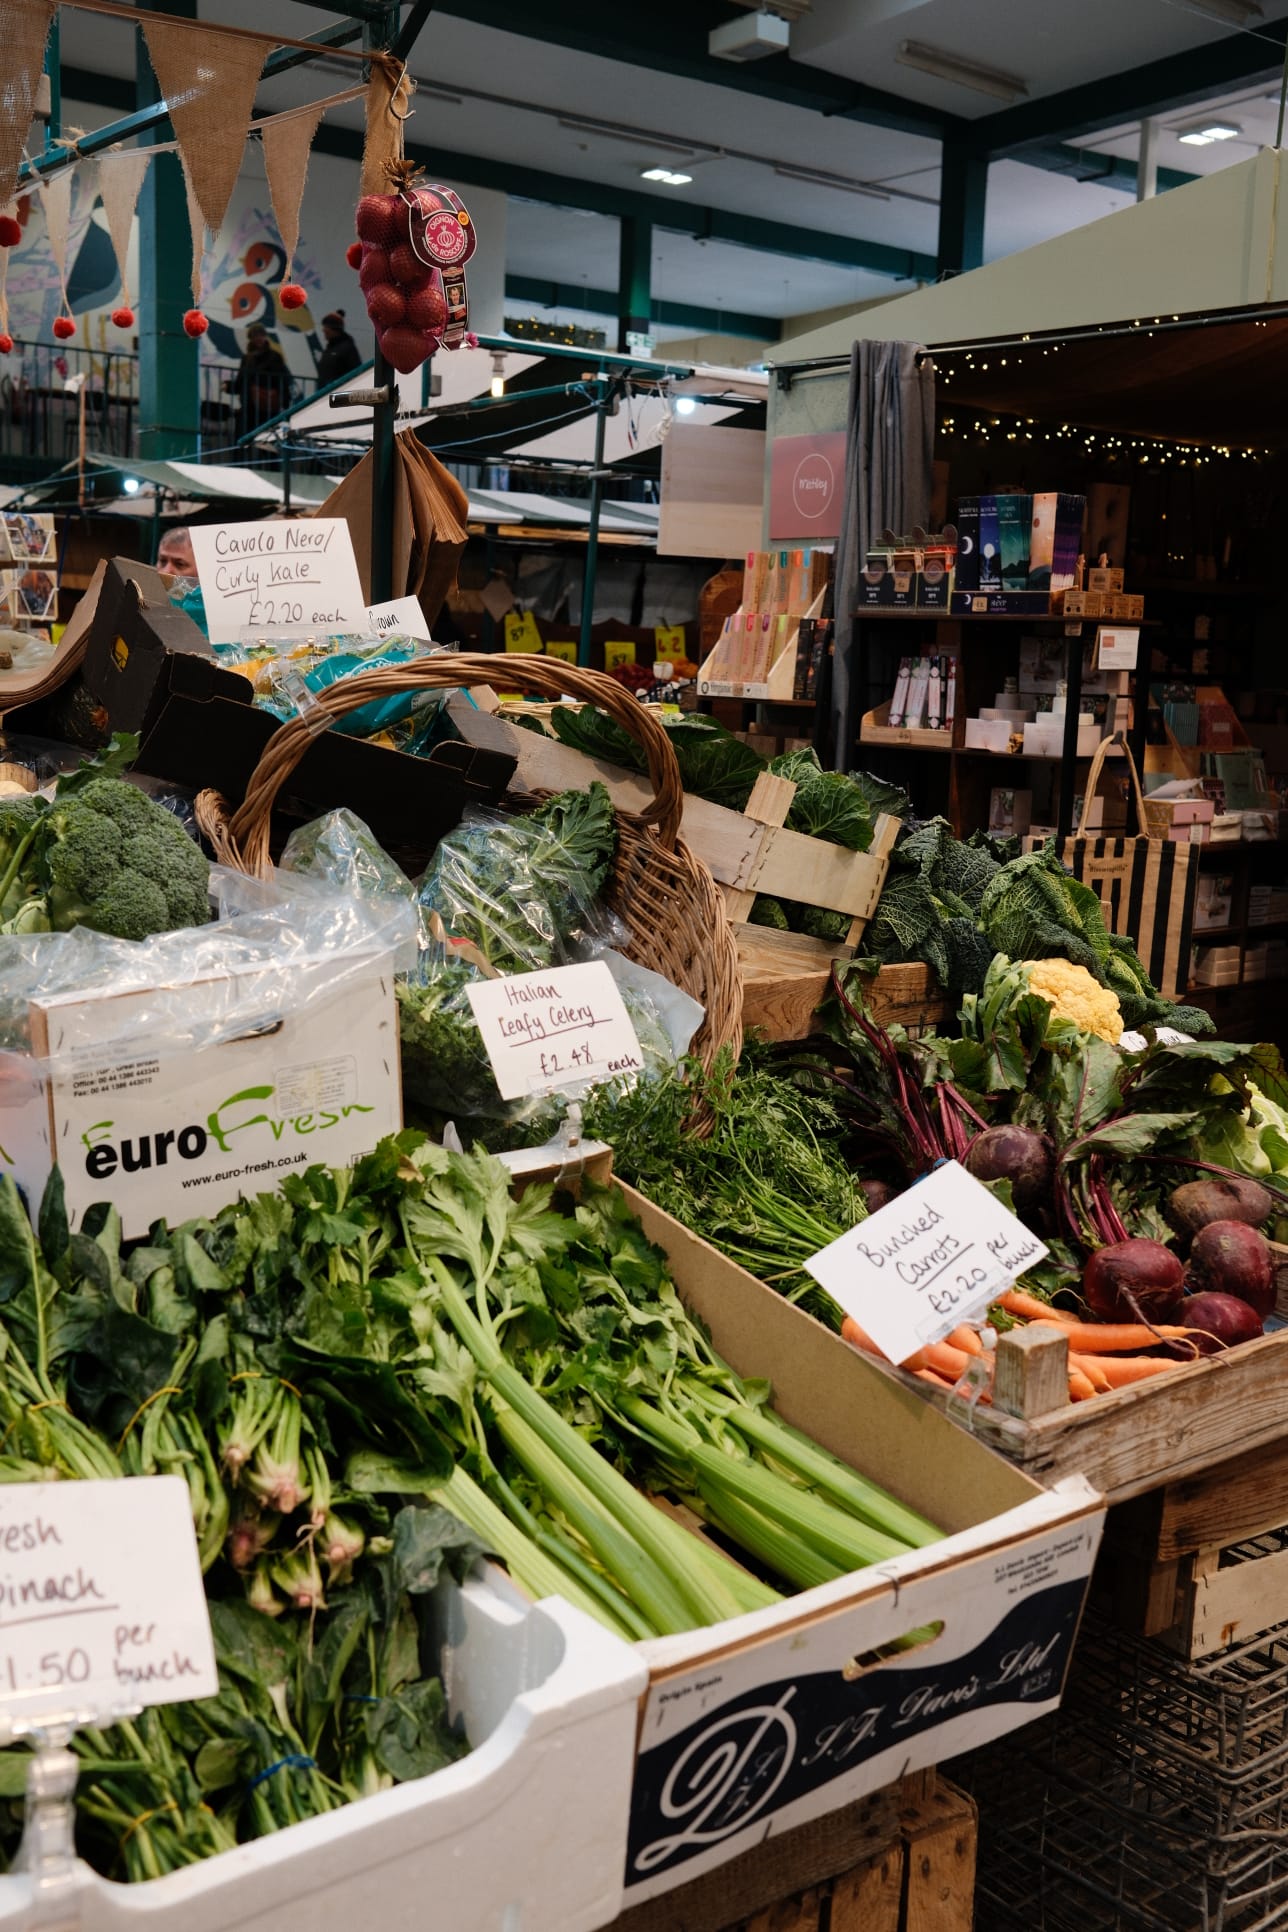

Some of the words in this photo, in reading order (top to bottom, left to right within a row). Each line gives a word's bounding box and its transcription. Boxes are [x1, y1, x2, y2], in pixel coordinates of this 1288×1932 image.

[430, 215, 455, 230] OIGNON
[215, 530, 274, 555] Cavolo
[286, 526, 335, 553] Nero/
[215, 565, 260, 603] Curly
[249, 601, 303, 626] £2.20
[312, 608, 347, 624] each
[504, 983, 562, 1006] Italian
[498, 1012, 547, 1040] Leafy
[550, 1004, 596, 1028] Celery
[540, 1041, 594, 1077] £2.48
[607, 1053, 640, 1072] each
[182, 1152, 308, 1189] www.euro-fresh.co.uk
[896, 1234, 960, 1285] Carrots
[928, 1267, 988, 1314] £2.20
[986, 1232, 1009, 1257] per
[1000, 1241, 1039, 1270] bunch
[114, 1623, 156, 1656] per
[113, 1650, 200, 1685] bunch
